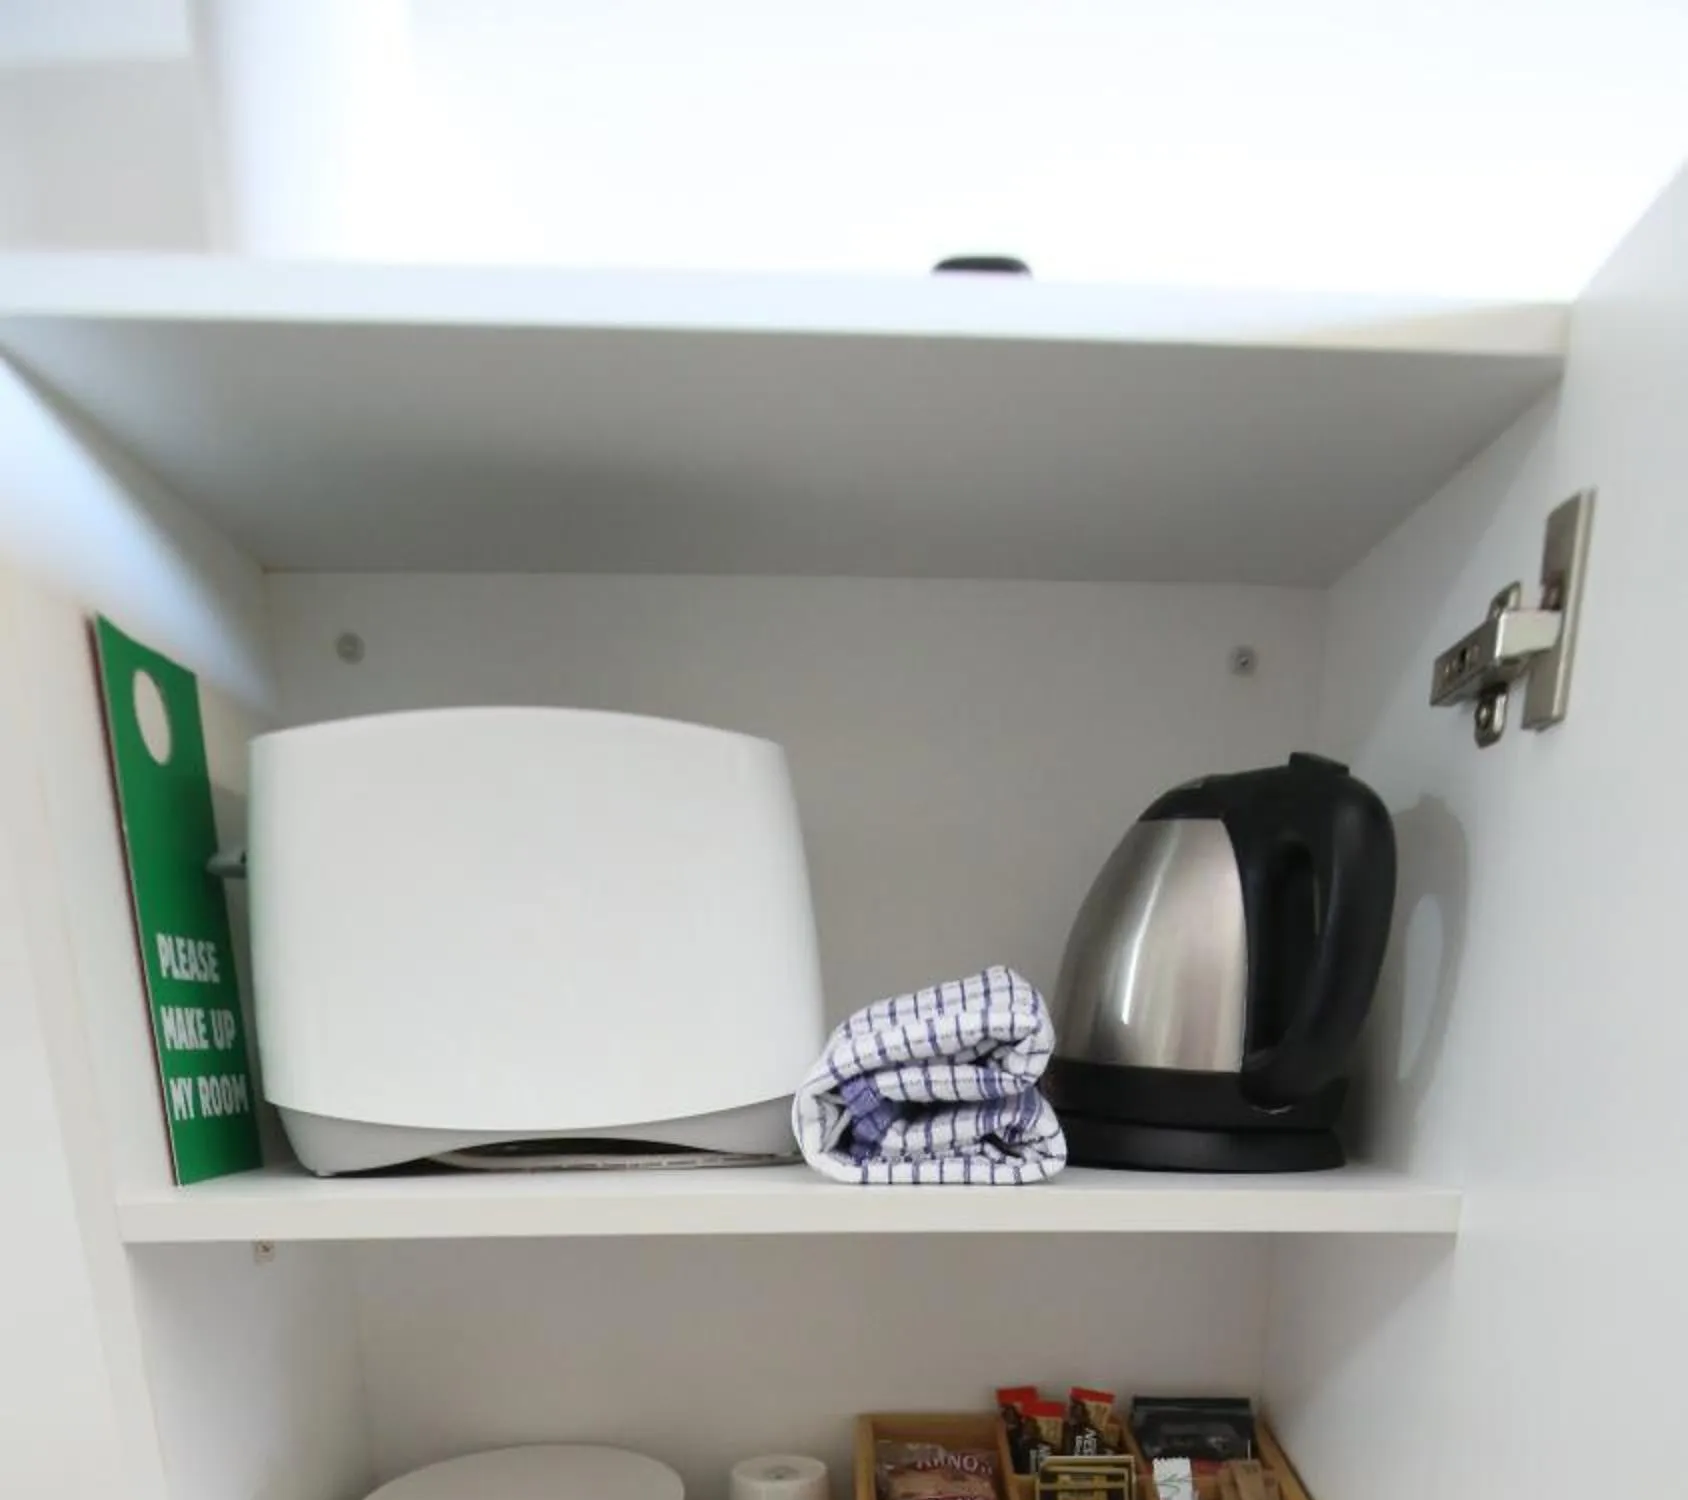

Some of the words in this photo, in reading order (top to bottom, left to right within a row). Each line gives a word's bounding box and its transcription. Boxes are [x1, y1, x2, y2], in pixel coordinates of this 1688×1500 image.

[156, 932, 220, 983] PLEASE
[160, 1005, 209, 1050] MAKE
[210, 1009, 236, 1050] UP
[169, 1077, 195, 1121] MY
[197, 1074, 249, 1118] ROOM
